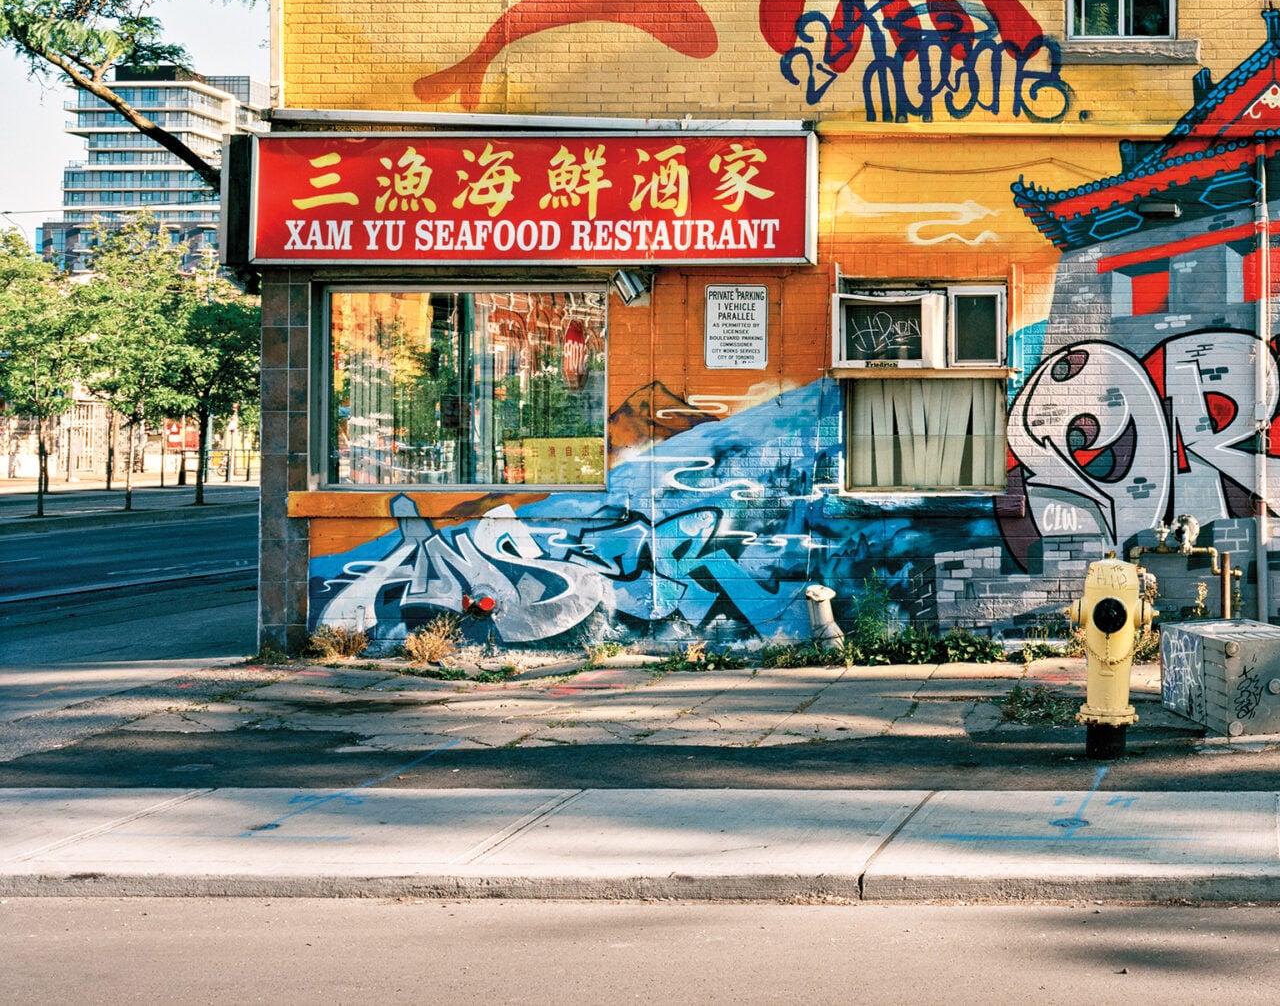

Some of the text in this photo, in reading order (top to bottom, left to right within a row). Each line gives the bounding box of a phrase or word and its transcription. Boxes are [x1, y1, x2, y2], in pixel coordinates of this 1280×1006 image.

[291, 142, 776, 221] 三漁海鮮酒家
[283, 218, 780, 251] XAM YU SEAFOOD RESTAURANT
[708, 290, 765, 301] PRIVATE PARKING
[724, 302, 756, 311] VEHICLE
[717, 312, 756, 321] PARALLEL
